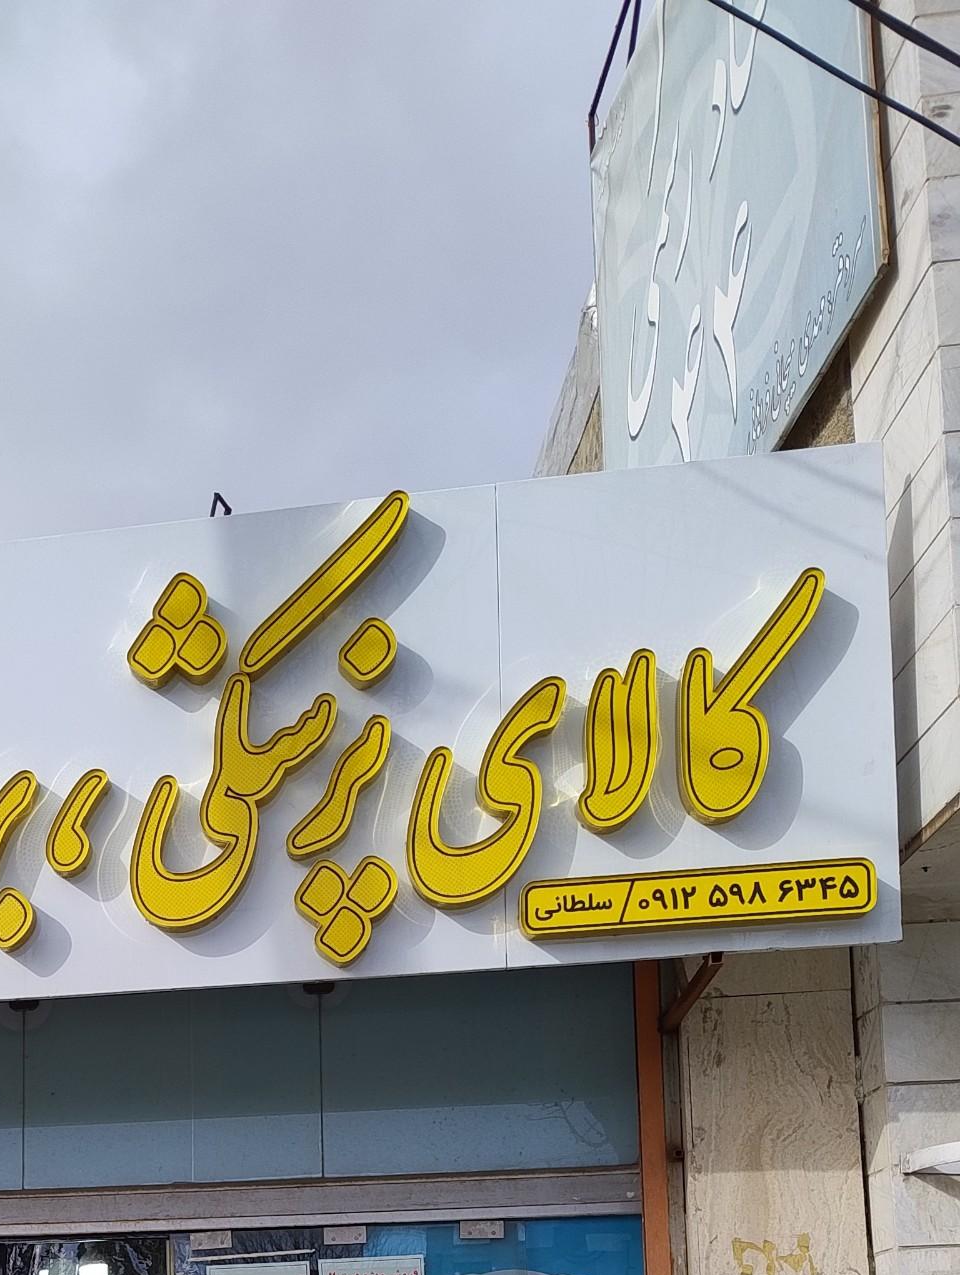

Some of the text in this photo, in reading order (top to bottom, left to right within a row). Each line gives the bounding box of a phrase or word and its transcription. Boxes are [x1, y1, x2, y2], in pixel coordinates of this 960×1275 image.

[405, 567, 826, 909] کالای
[535, 875, 859, 922] ۰۹۱۲ ۵۹۸ ۶۳۴۵ سلطانی
